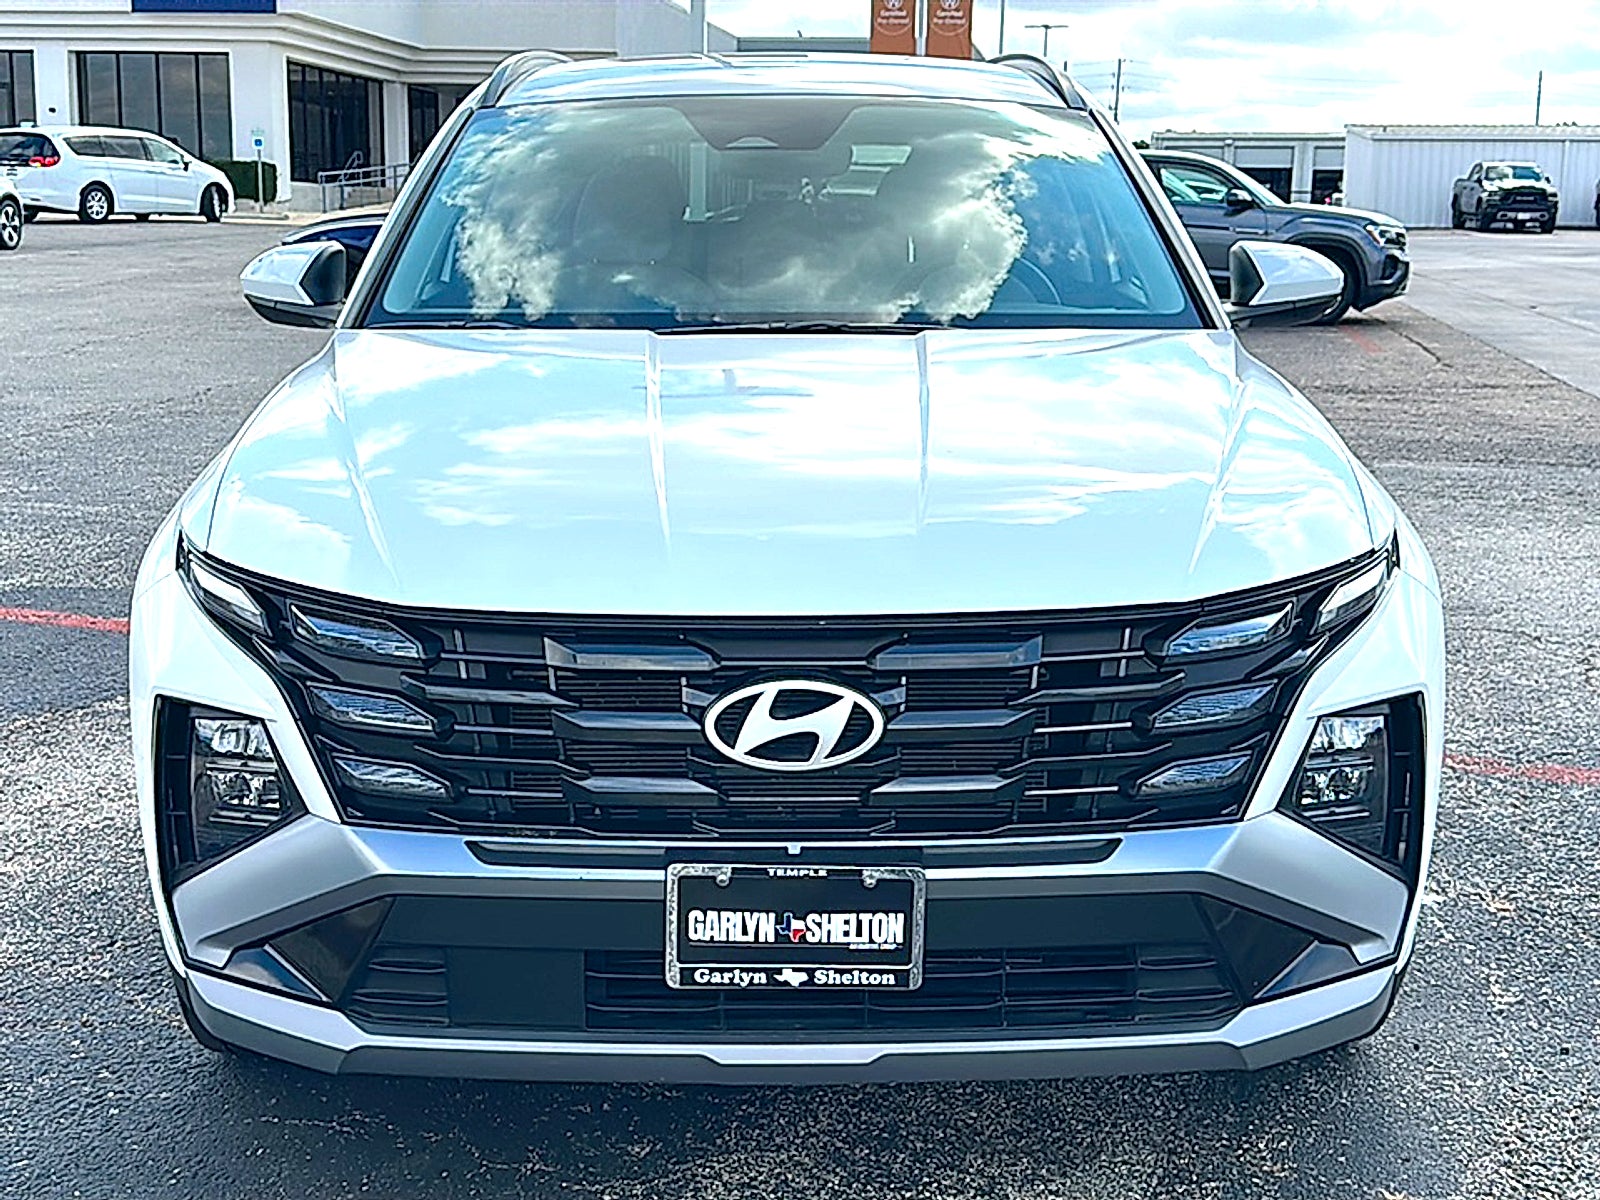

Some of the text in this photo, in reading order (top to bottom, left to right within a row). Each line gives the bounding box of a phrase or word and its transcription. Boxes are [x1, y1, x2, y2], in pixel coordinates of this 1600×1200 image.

[767, 868, 828, 877] TEMPLE
[688, 910, 905, 943] GARLYN SHELTON
[694, 968, 896, 988] Garlyn Shelton
